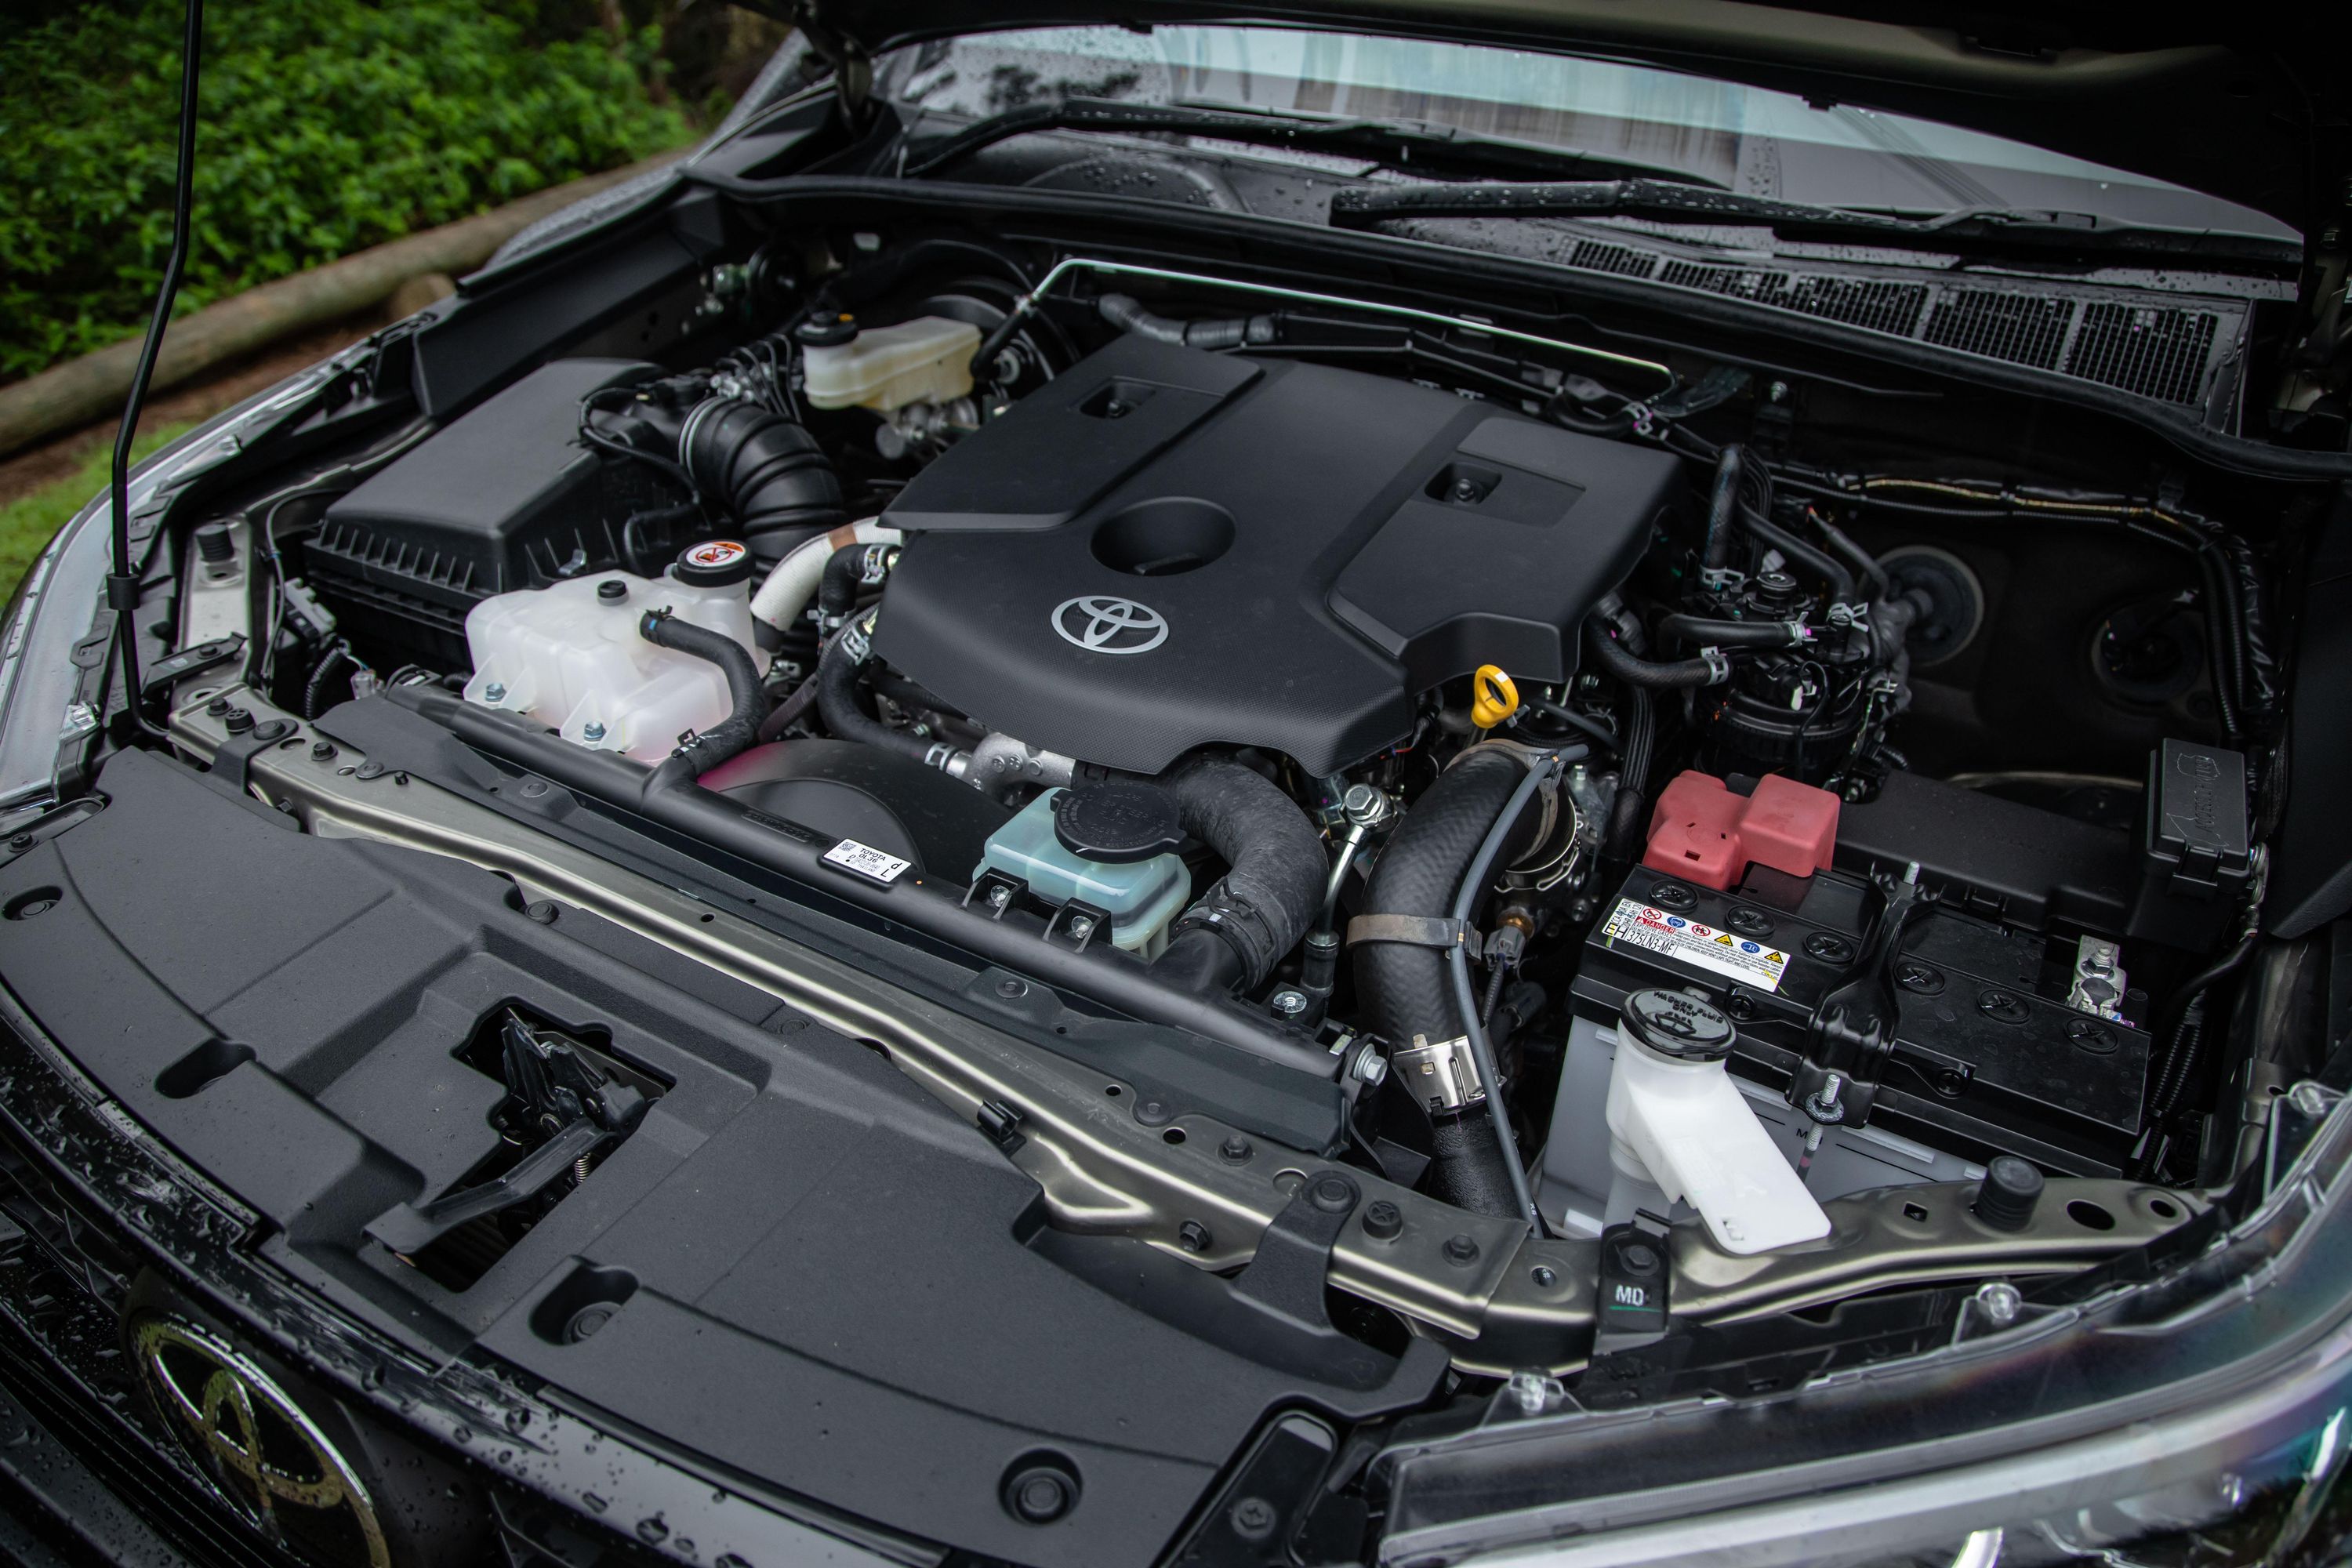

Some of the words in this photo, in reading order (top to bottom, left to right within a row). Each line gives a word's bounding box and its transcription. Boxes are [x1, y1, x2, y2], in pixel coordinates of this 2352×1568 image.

[860, 848, 885, 861] TOYOTA
[1604, 922, 1628, 938] EH
[1633, 920, 1657, 933] EXPLOSIVE
[1657, 929, 1672, 938] GASES
[1645, 920, 1675, 933] DANGER
[1627, 931, 1674, 953] 375LN3-MF
[1615, 1284, 1645, 1307] MD
